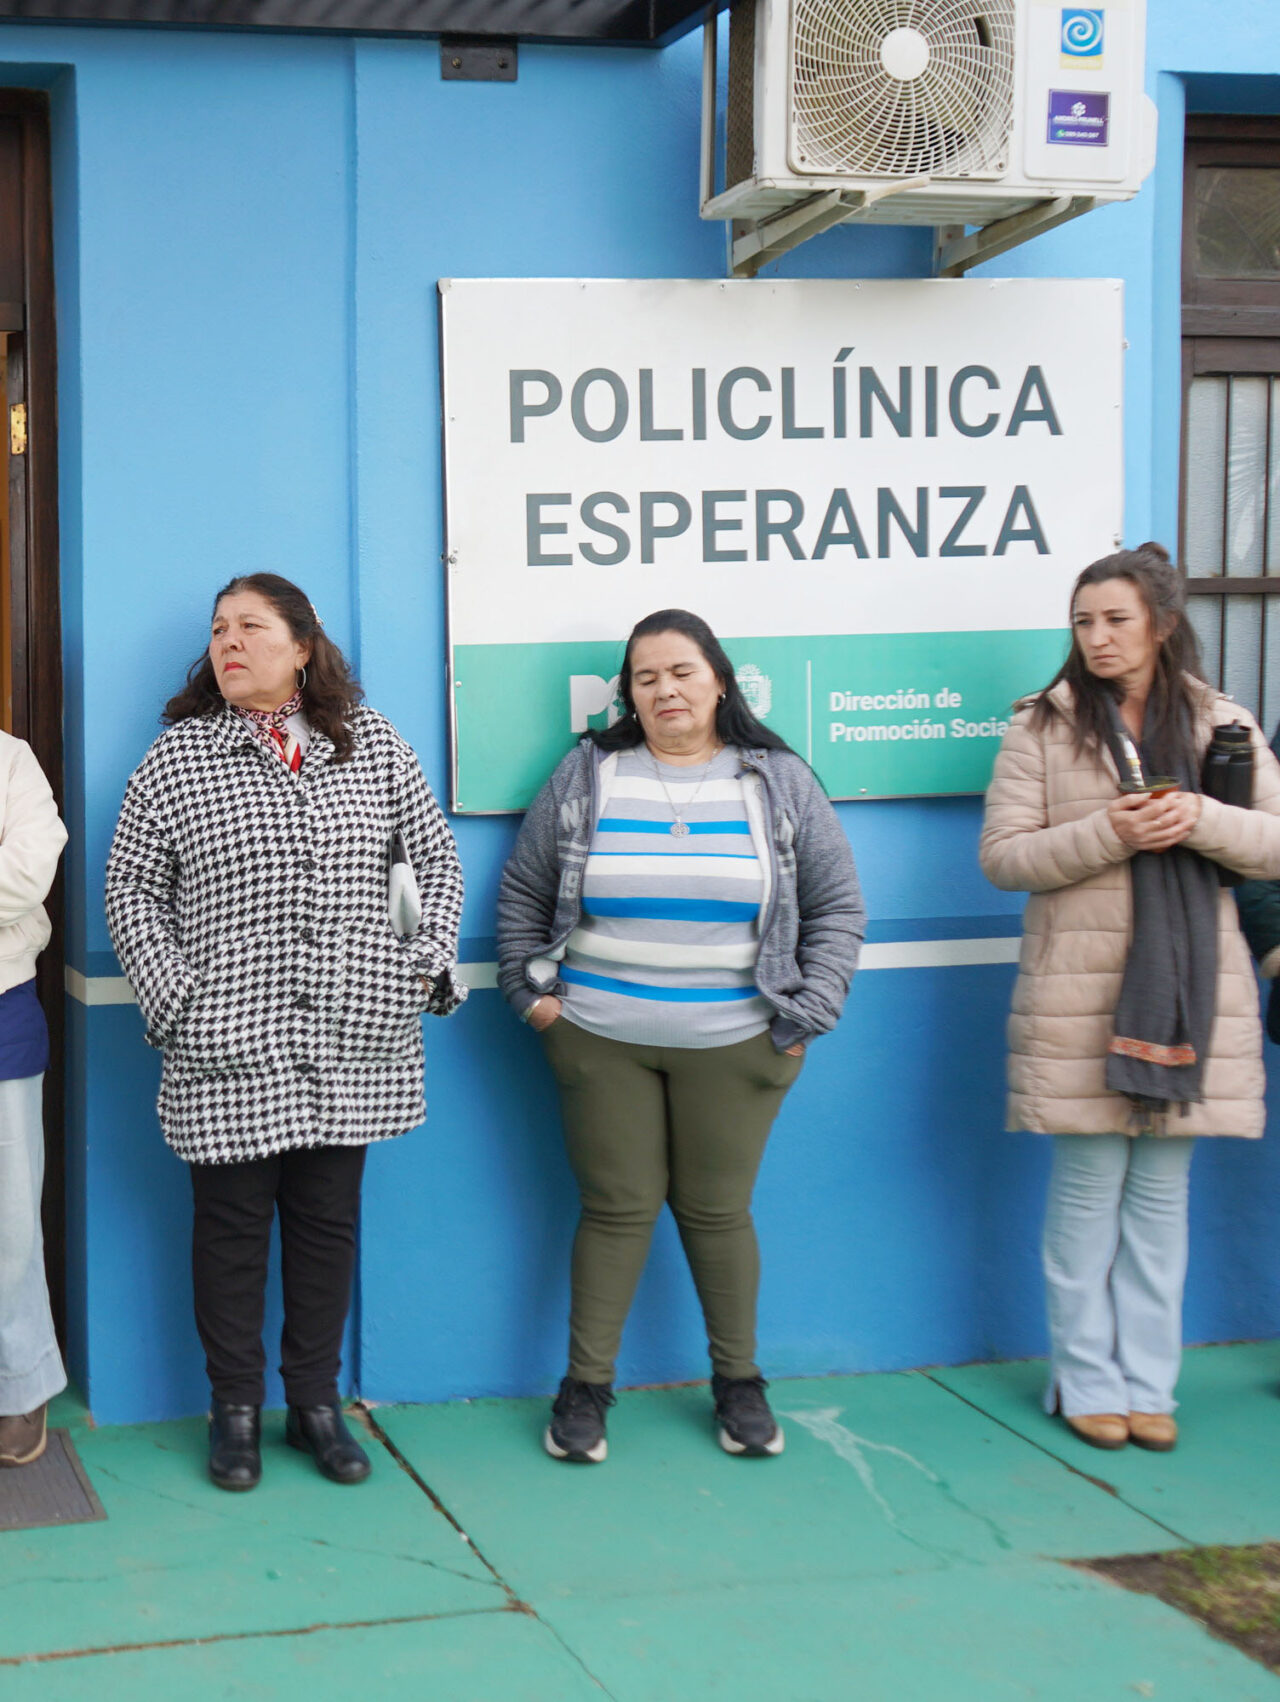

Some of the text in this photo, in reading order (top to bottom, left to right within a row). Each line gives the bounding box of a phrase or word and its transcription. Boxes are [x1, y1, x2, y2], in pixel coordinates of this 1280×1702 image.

[508, 346, 1064, 444] POLICLÍNICA
[525, 484, 1051, 567] ESPERANZA
[829, 687, 962, 712] Dirección de
[829, 718, 946, 743] Promoción
